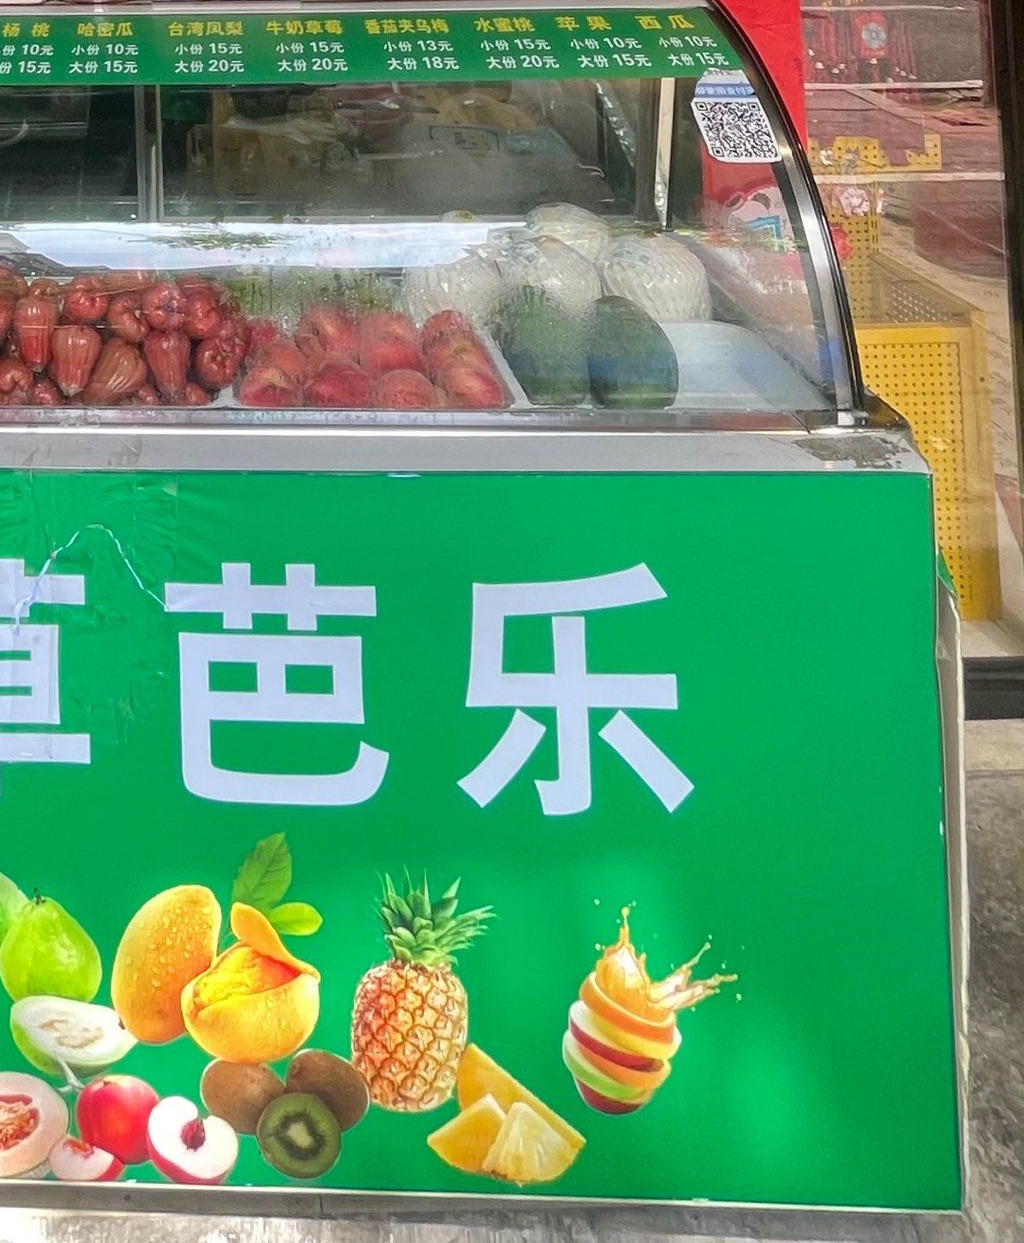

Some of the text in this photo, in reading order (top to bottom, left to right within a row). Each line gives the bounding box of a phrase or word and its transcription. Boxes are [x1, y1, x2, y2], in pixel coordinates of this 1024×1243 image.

[77, 21, 133, 36] 哈密瓜
[168, 21, 243, 36] 台湾凤梨
[265, 20, 343, 35] 牛奶草莓
[364, 18, 449, 34] 番茄夹乌梅
[474, 17, 535, 32] 水蜜桃
[556, 16, 611, 31] 苹果
[635, 15, 693, 29] 西瓜
[2, 22, 50, 37] 杨桃
[276, 42, 344, 53] 小份 15元
[384, 40, 453, 52] 小份 13元
[481, 39, 551, 51] 小份 15元
[571, 37, 641, 49] 小份 10元
[659, 36, 717, 47] 小份 10元
[22, 44, 53, 55] 10元
[72, 44, 138, 55] 小份 10元
[175, 43, 243, 55] 小份 15元
[278, 58, 348, 71] 大份 20元
[388, 56, 459, 70] 大份 18元
[486, 55, 559, 69] 大份 20元
[578, 54, 651, 69] 大份 15元
[668, 52, 729, 66] 大份 15元
[19, 61, 51, 74] 15元
[69, 60, 137, 73] 大份 15元
[175, 60, 244, 72] 大份 20元
